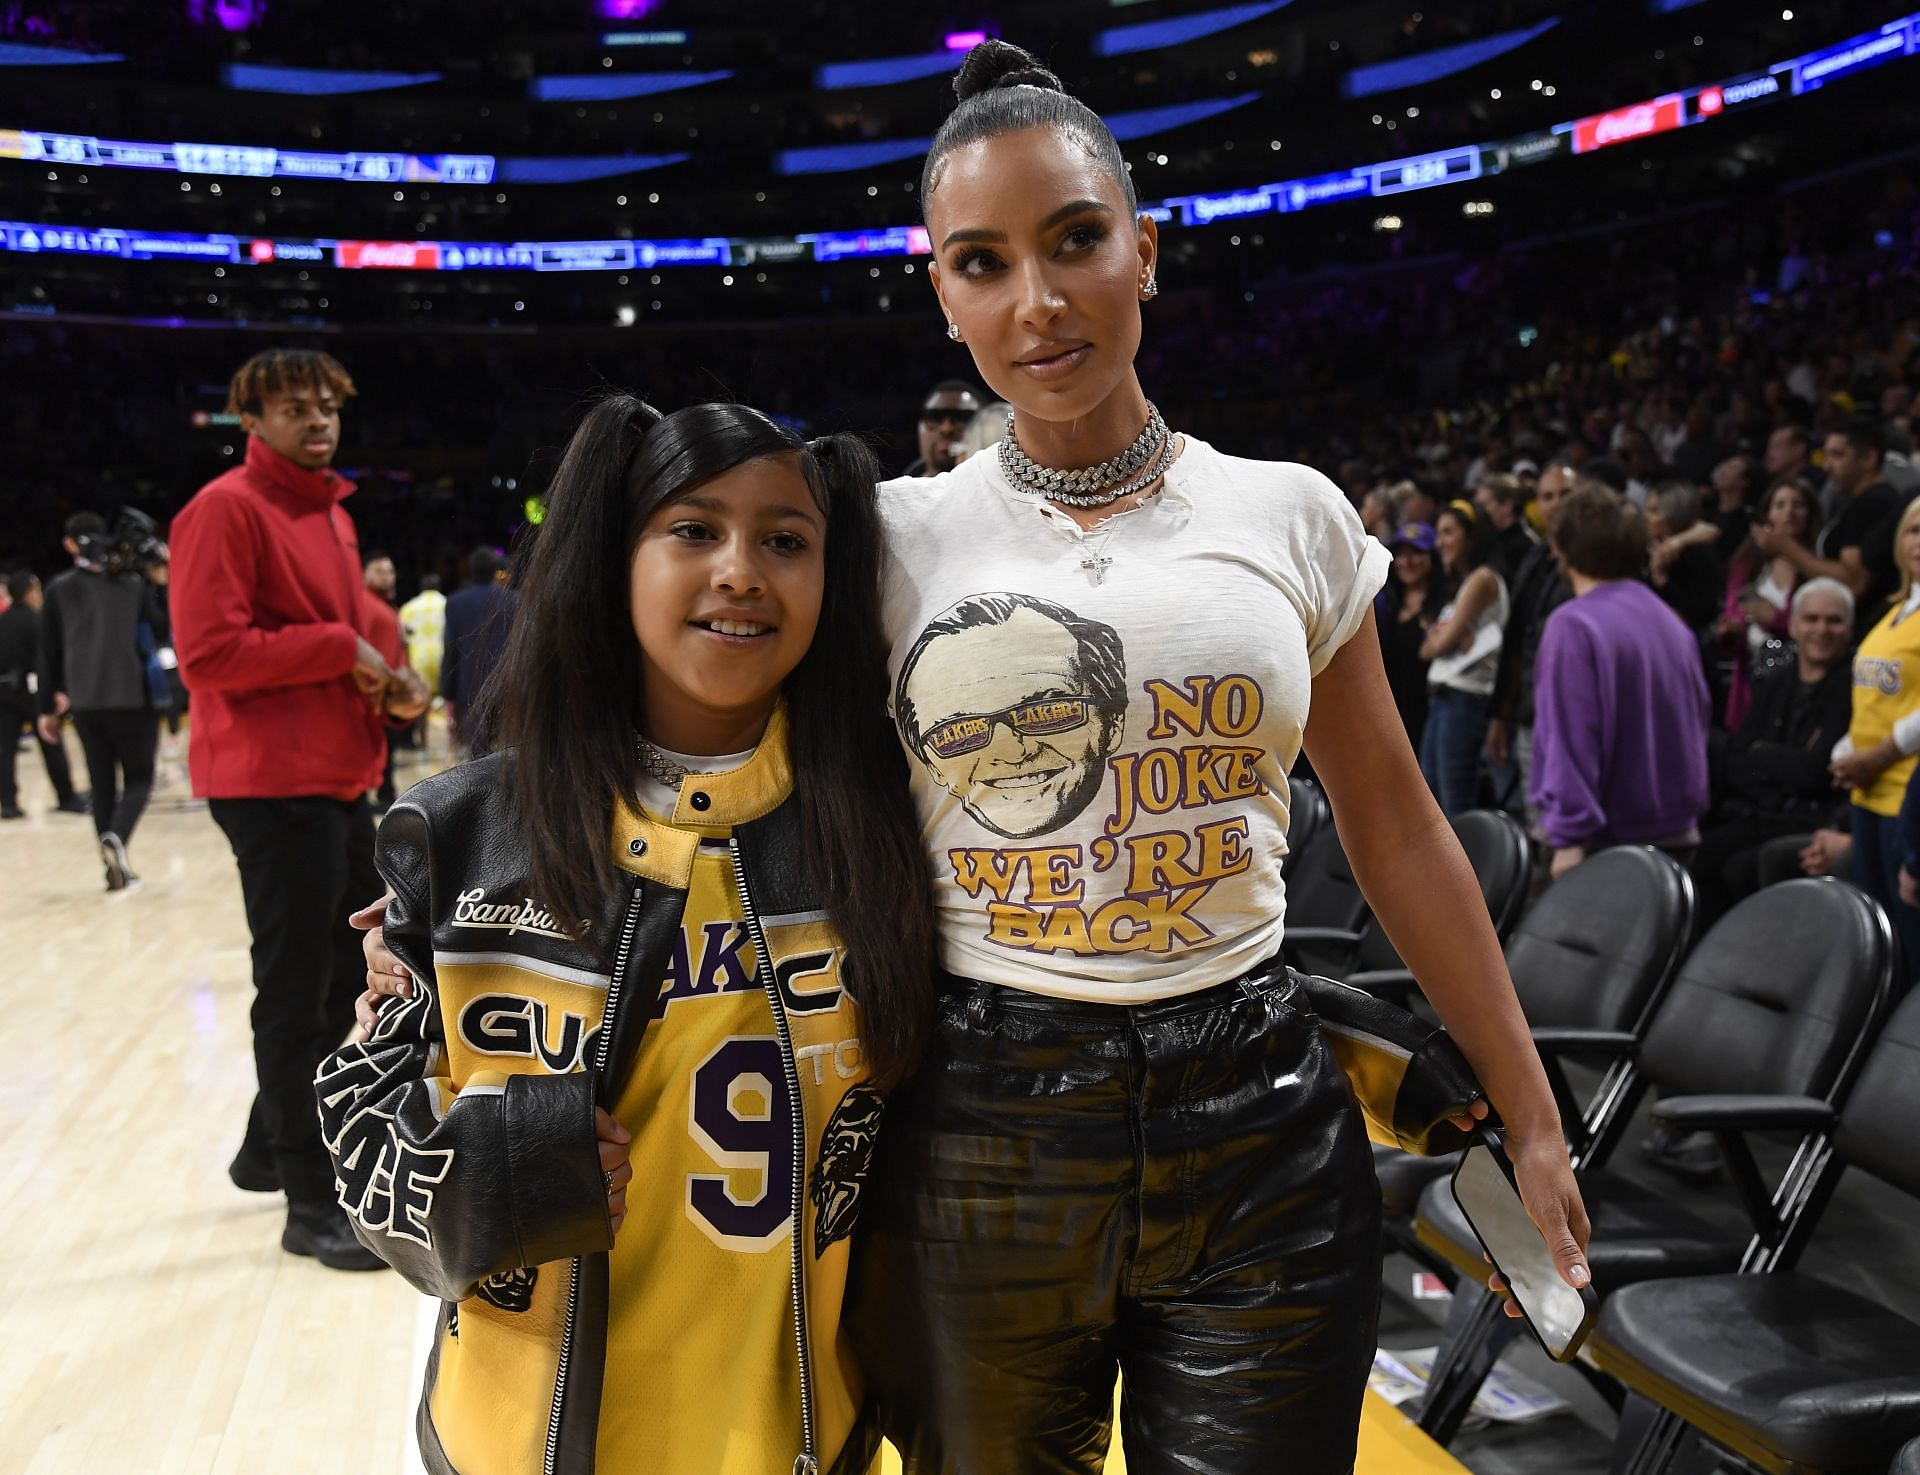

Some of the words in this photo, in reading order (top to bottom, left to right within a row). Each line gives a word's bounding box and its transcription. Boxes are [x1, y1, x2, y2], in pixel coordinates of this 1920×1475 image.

[42, 230, 119, 252] DELTA
[464, 247, 532, 266] DELTA
[930, 717, 989, 748] LAKERS
[1009, 701, 1082, 727] LAKERS
[1144, 674, 1264, 740] NO
[948, 817, 1252, 905] WE'RE
[983, 881, 1216, 957] BACK
[458, 992, 603, 1075] GU
[686, 1034, 798, 1254] 9
